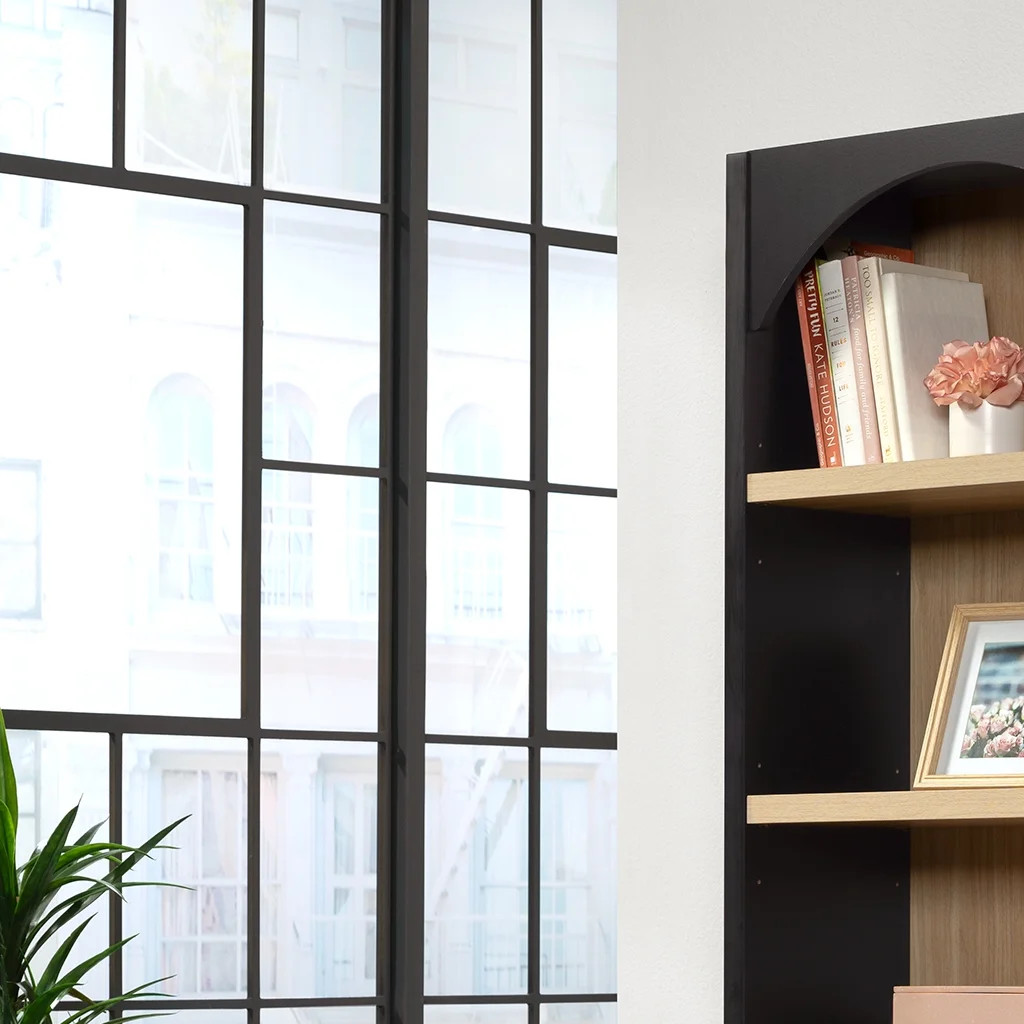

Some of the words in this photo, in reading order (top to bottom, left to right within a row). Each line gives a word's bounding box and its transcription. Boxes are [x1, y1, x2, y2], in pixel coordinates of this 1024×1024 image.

[862, 264, 872, 288] TOO
[851, 277, 861, 320] PATRICIA
[865, 291, 876, 325] SMALL
[810, 312, 822, 338] FUN
[854, 327, 862, 346] food
[831, 337, 847, 347] RULES
[814, 343, 828, 380] KATE
[857, 361, 867, 390] family
[861, 391, 869, 408] and
[819, 384, 836, 447] HUDSON
[862, 407, 873, 440] friends
